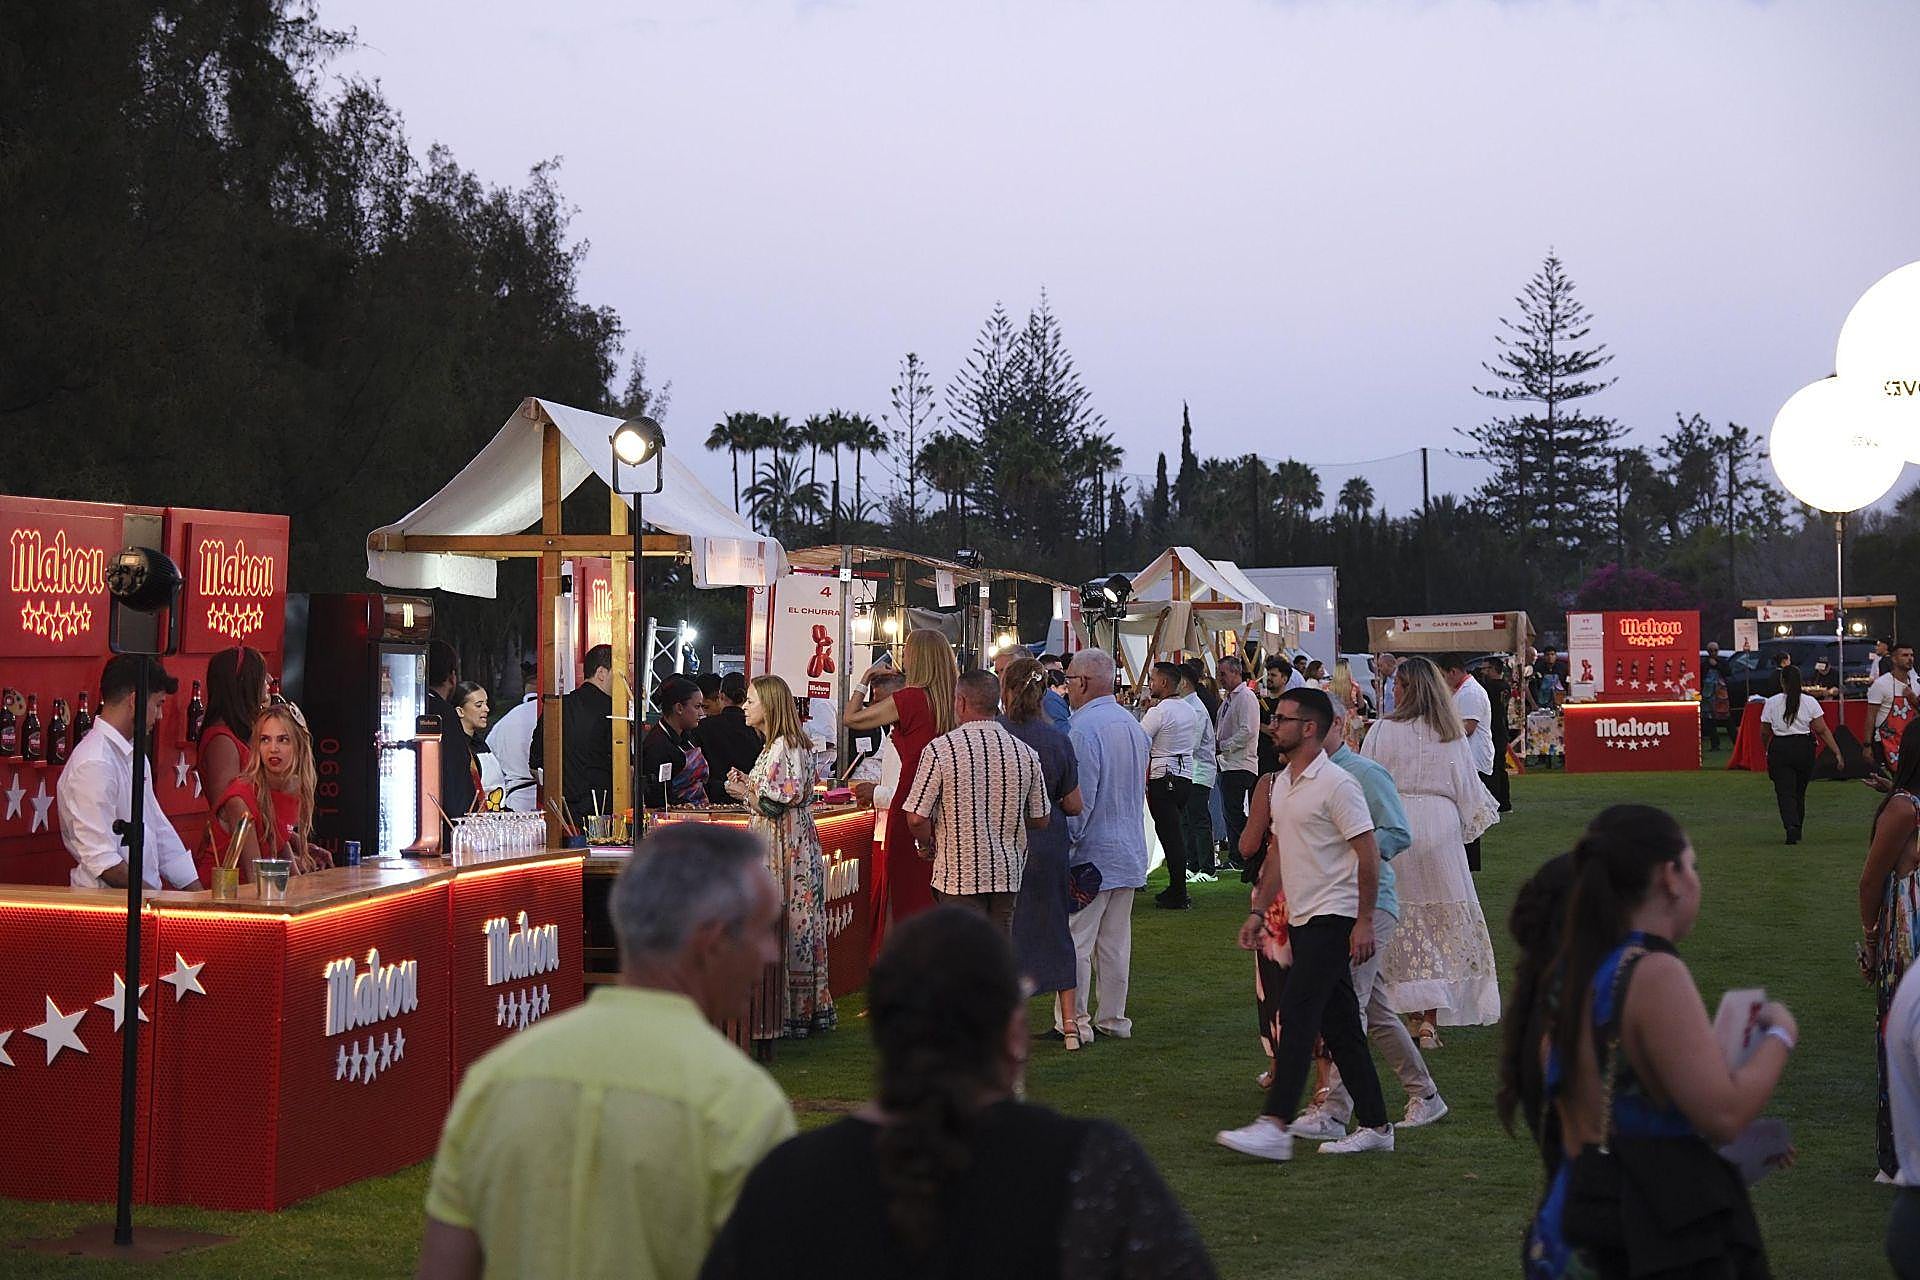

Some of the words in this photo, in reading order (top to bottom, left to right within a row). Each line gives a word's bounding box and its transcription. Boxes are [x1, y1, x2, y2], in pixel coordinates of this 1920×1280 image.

[11, 530, 104, 594] Mahou
[200, 540, 274, 596] Mahou
[820, 586, 832, 598] 4
[1620, 618, 1682, 636] Mahou
[1594, 717, 1670, 737] Mahou
[320, 738, 340, 816] 1890
[484, 910, 560, 986] Mahou
[324, 947, 419, 1037] Mahou
